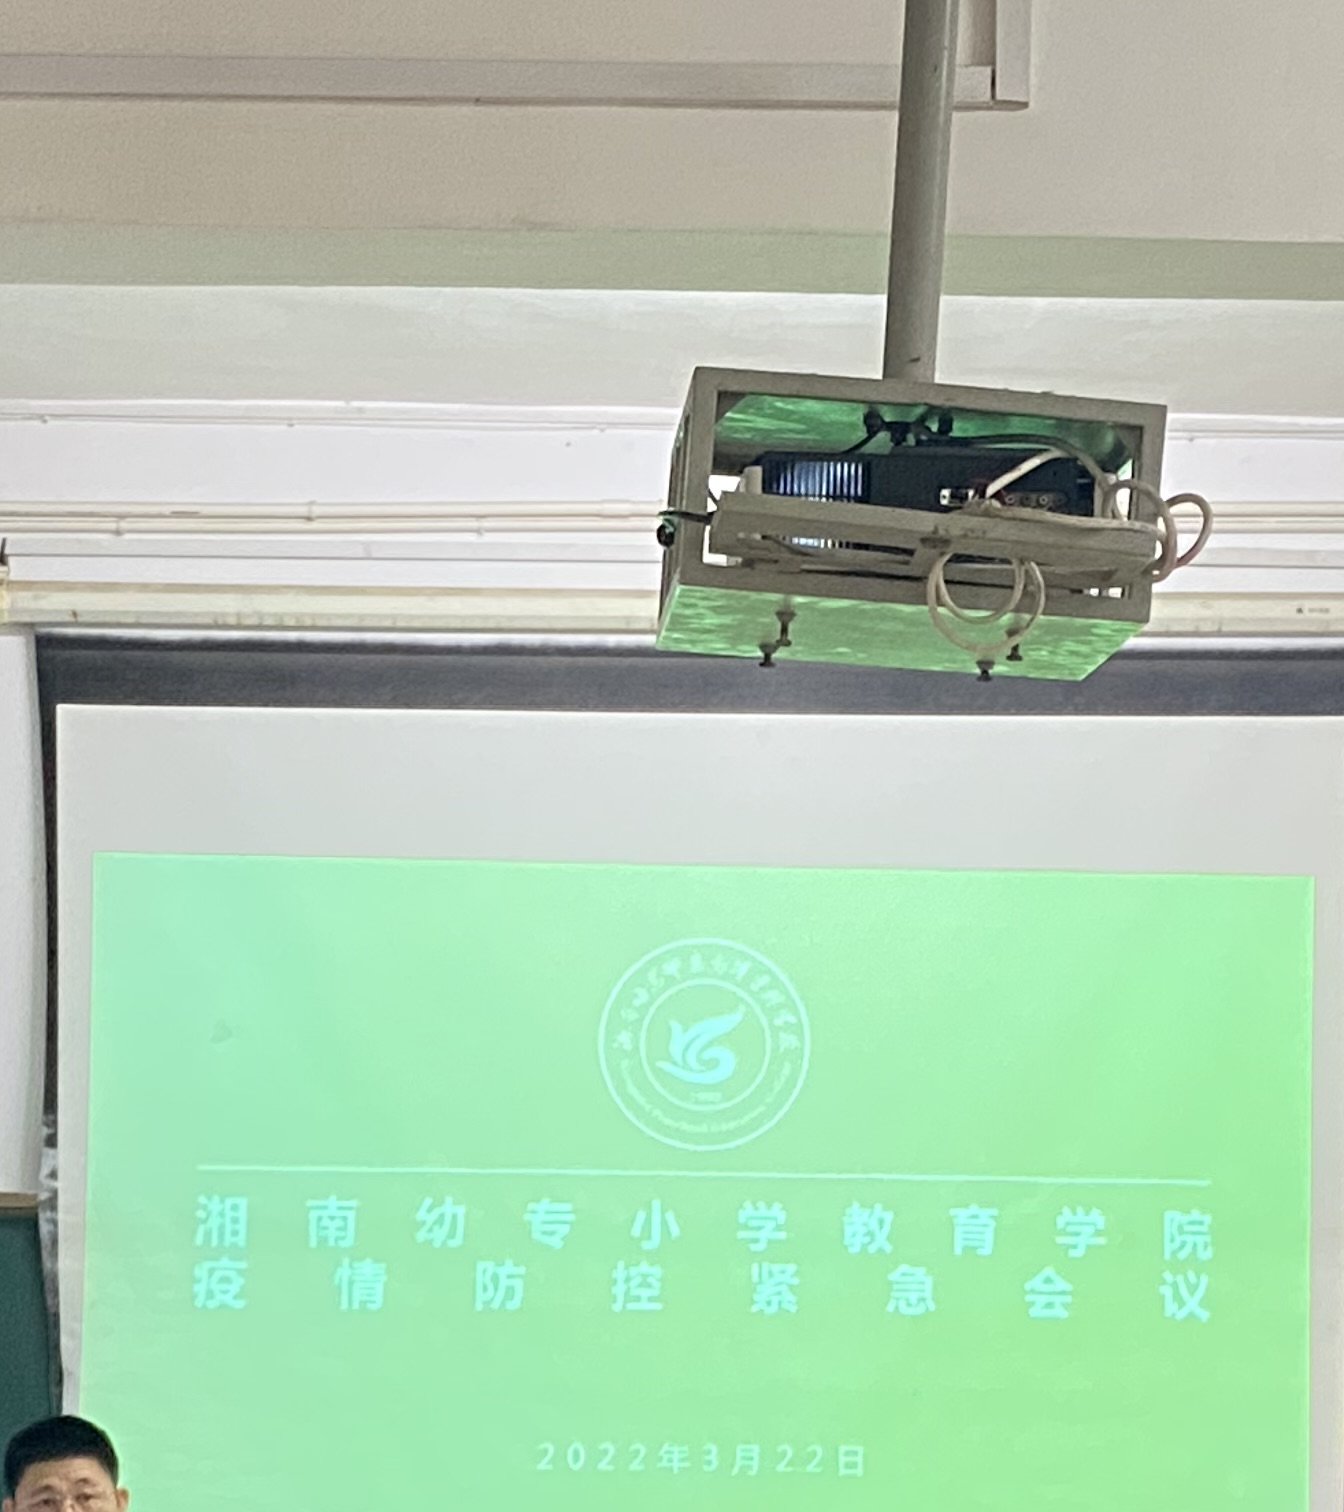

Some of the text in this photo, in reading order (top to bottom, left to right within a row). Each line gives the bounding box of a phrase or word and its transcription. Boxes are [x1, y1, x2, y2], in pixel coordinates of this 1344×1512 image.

[194, 1195, 1213, 1260] 湘南幼专小学教育学院
[193, 1256, 1212, 1322] 疫情防控紧急会议
[536, 1441, 865, 1476] 2022年3月22日
